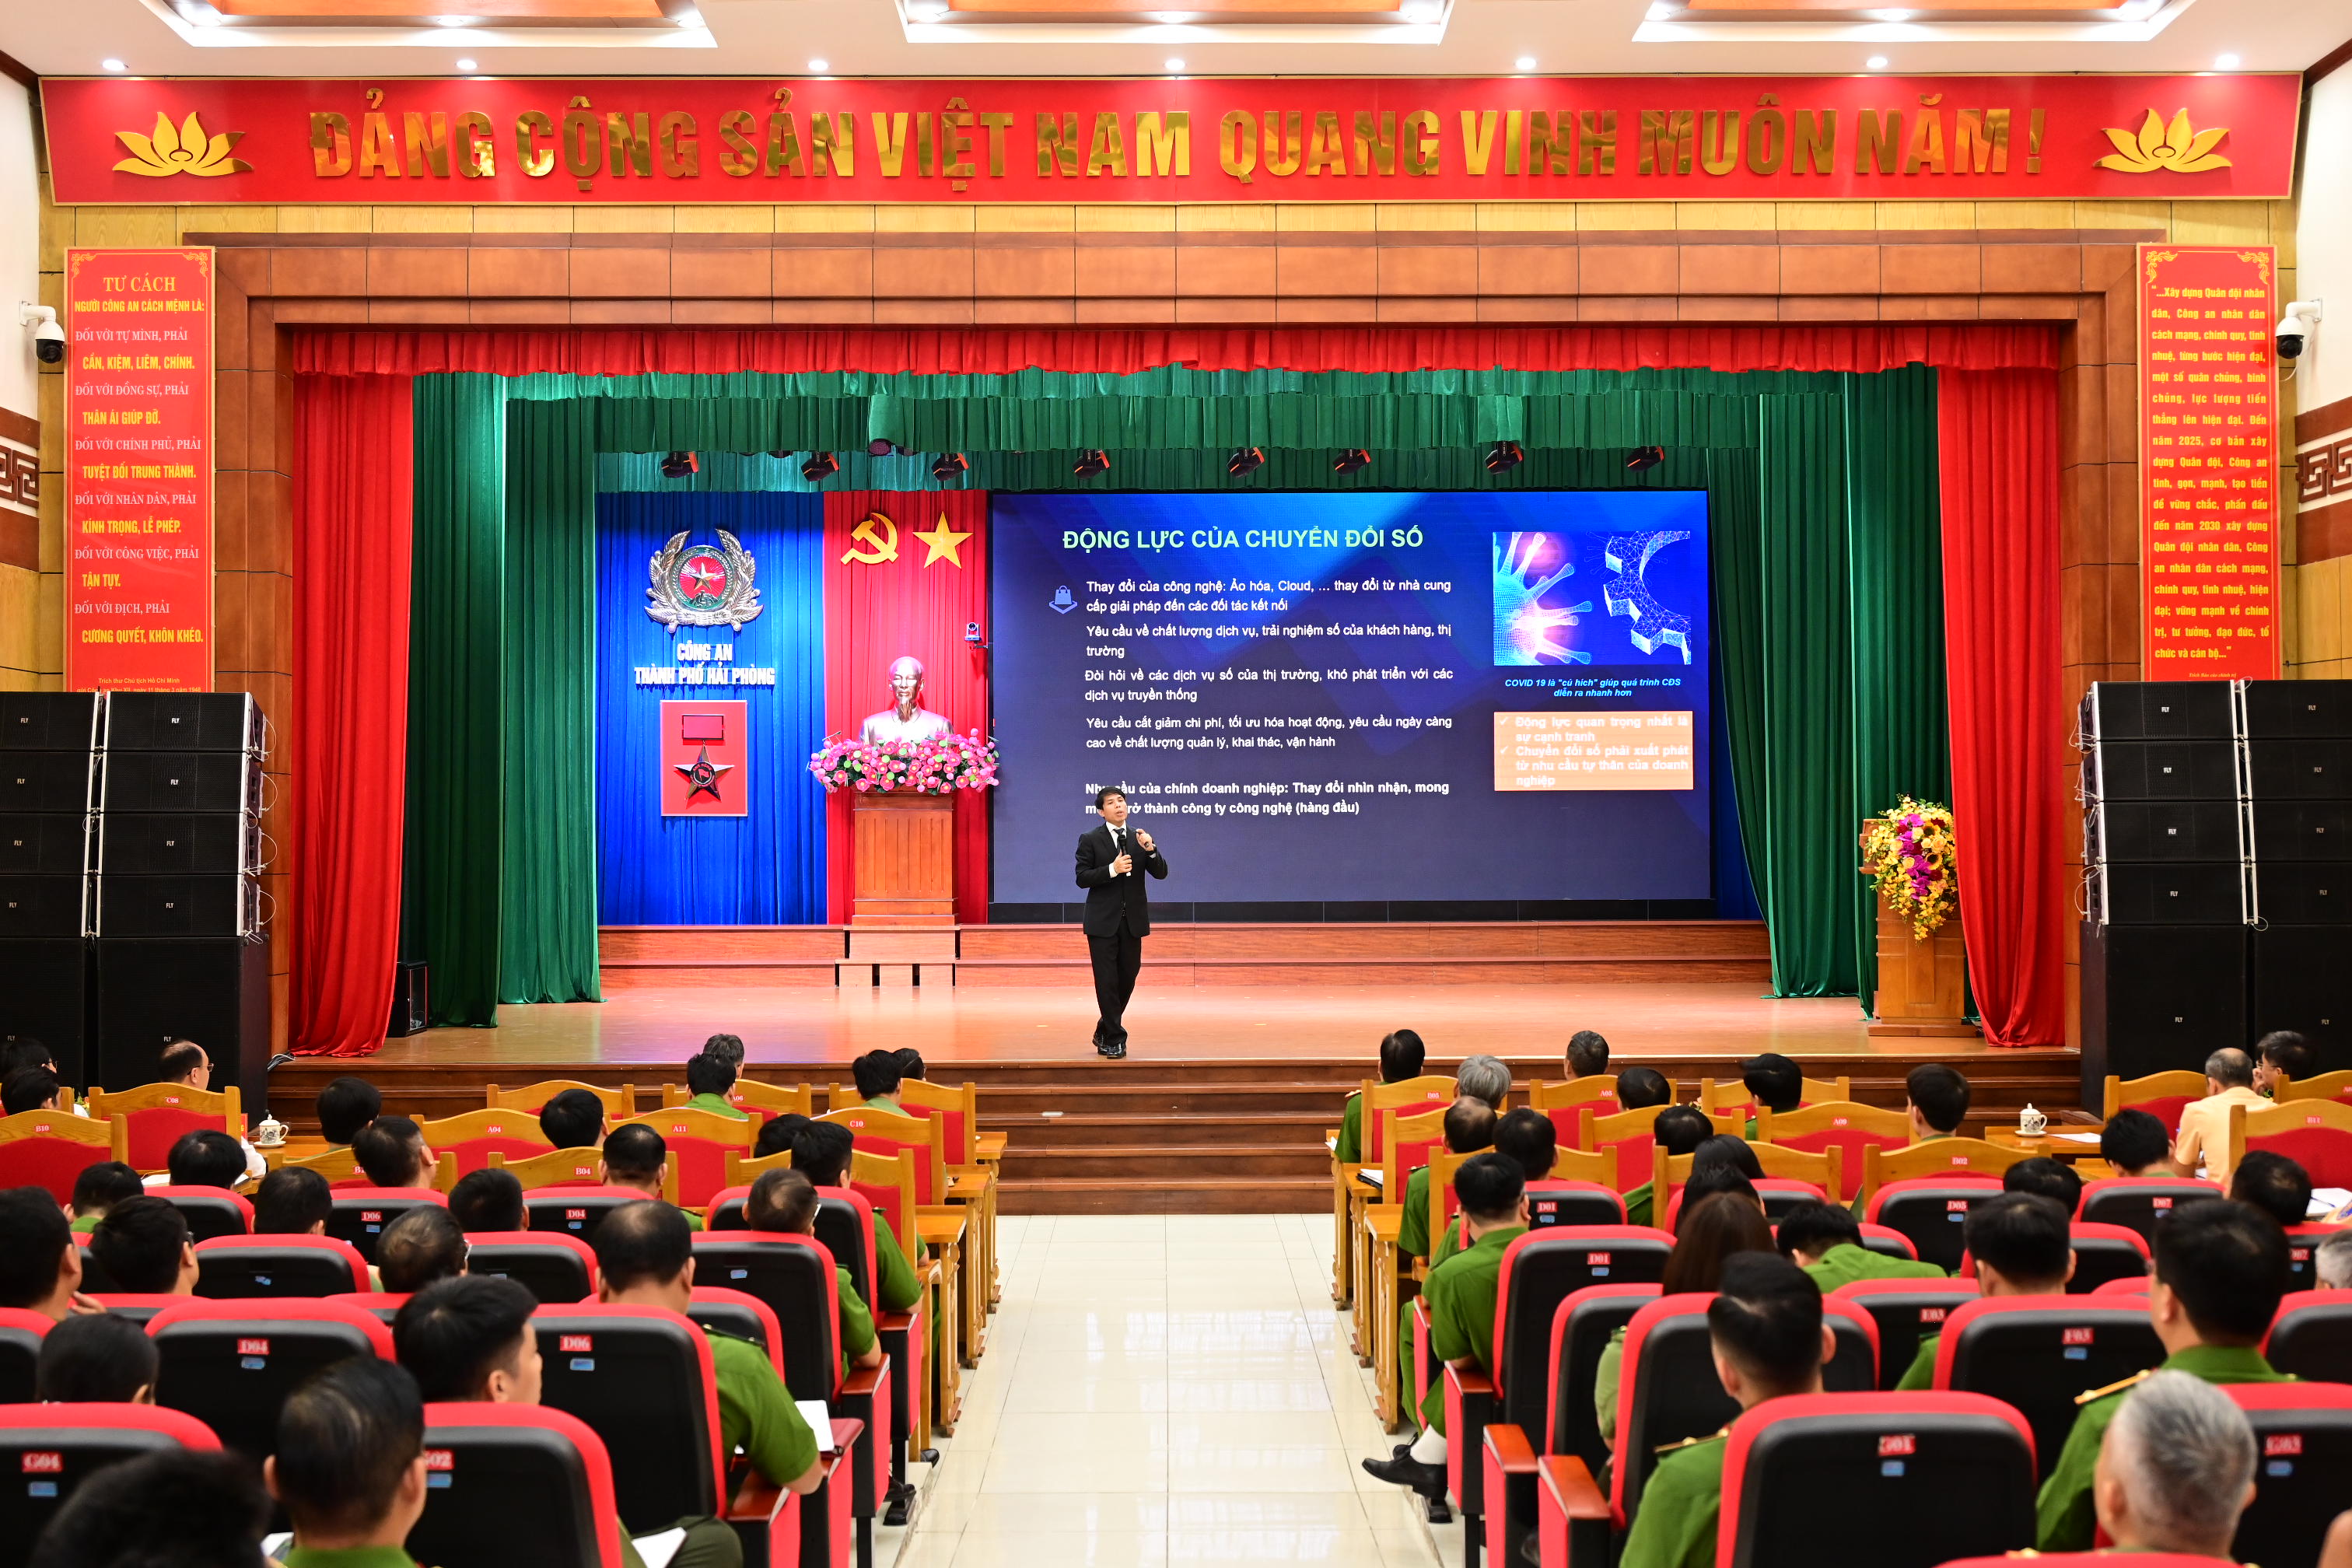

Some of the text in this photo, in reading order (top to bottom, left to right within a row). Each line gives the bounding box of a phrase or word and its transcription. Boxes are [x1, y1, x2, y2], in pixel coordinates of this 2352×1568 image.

[310, 88, 2046, 191] ĐẢNG CỘNG SẢN VIỆT NAM QUANG VINH MUÔN NĂM !
[103, 272, 177, 292] TƯ CÁCH
[74, 298, 205, 314] NGƯỜI CÔNG AN CÁCH MỆNH LÀ:
[75, 327, 187, 344] ĐỐI VỚI TỰ MÌNH, PHẢI
[2152, 435, 2173, 446] năm
[2178, 436, 2204, 446] 2025,
[2210, 437, 2222, 446] cơ
[2250, 436, 2267, 447] xây
[82, 461, 197, 481] TUYỆT ĐỐI TRUNG THÀNH.
[75, 490, 196, 506] ĐỐI VỚI NHÂN DÂN, PHẢI
[82, 517, 105, 534] KÍNH
[107, 520, 141, 536] TRỌNG,
[142, 516, 154, 534] LỄ
[2175, 520, 2194, 530] năm
[2199, 520, 2221, 530] 2030
[2225, 520, 2242, 532] xây
[2246, 520, 2268, 533] dựng
[1062, 524, 1423, 554] ĐỘNG LỰC CỦA CHUYỂN ĐỔI SỐ
[75, 544, 199, 562] ĐỐI VỚI CÔNG VIỆC, PHẢI
[82, 571, 121, 590] TẬN TỤY.
[1086, 581, 1115, 595] Thay
[1118, 578, 1136, 592] đổi
[1139, 579, 1160, 592] của
[1163, 580, 1191, 594] công
[1195, 580, 1226, 594] nghệ:
[1229, 577, 1246, 592] Ảo
[1249, 579, 1274, 593] hóa,
[1278, 580, 1314, 593] Cloud,
[1334, 579, 1359, 593] thay
[1361, 577, 1379, 591] đổi
[1382, 579, 1395, 591] từ
[1398, 579, 1420, 591] nhà
[1423, 581, 1451, 593] cung
[75, 599, 170, 616] ĐỐI VỚI ĐỊCH, PHẢI
[1086, 597, 1288, 614] cấp giải pháp đến các đối tác kết nối
[677, 639, 732, 660] CÔNG AN
[1086, 645, 1125, 659] trường
[634, 661, 775, 684] THÀNH PHỐ HẢI PHÒNG
[1084, 666, 1454, 683] Đòi hỏi về các dịch vụ số của thị trường, khó phát triển với các
[1084, 687, 1198, 703] dịch vụ truyền thống
[1585, 688, 1613, 697] nhanh
